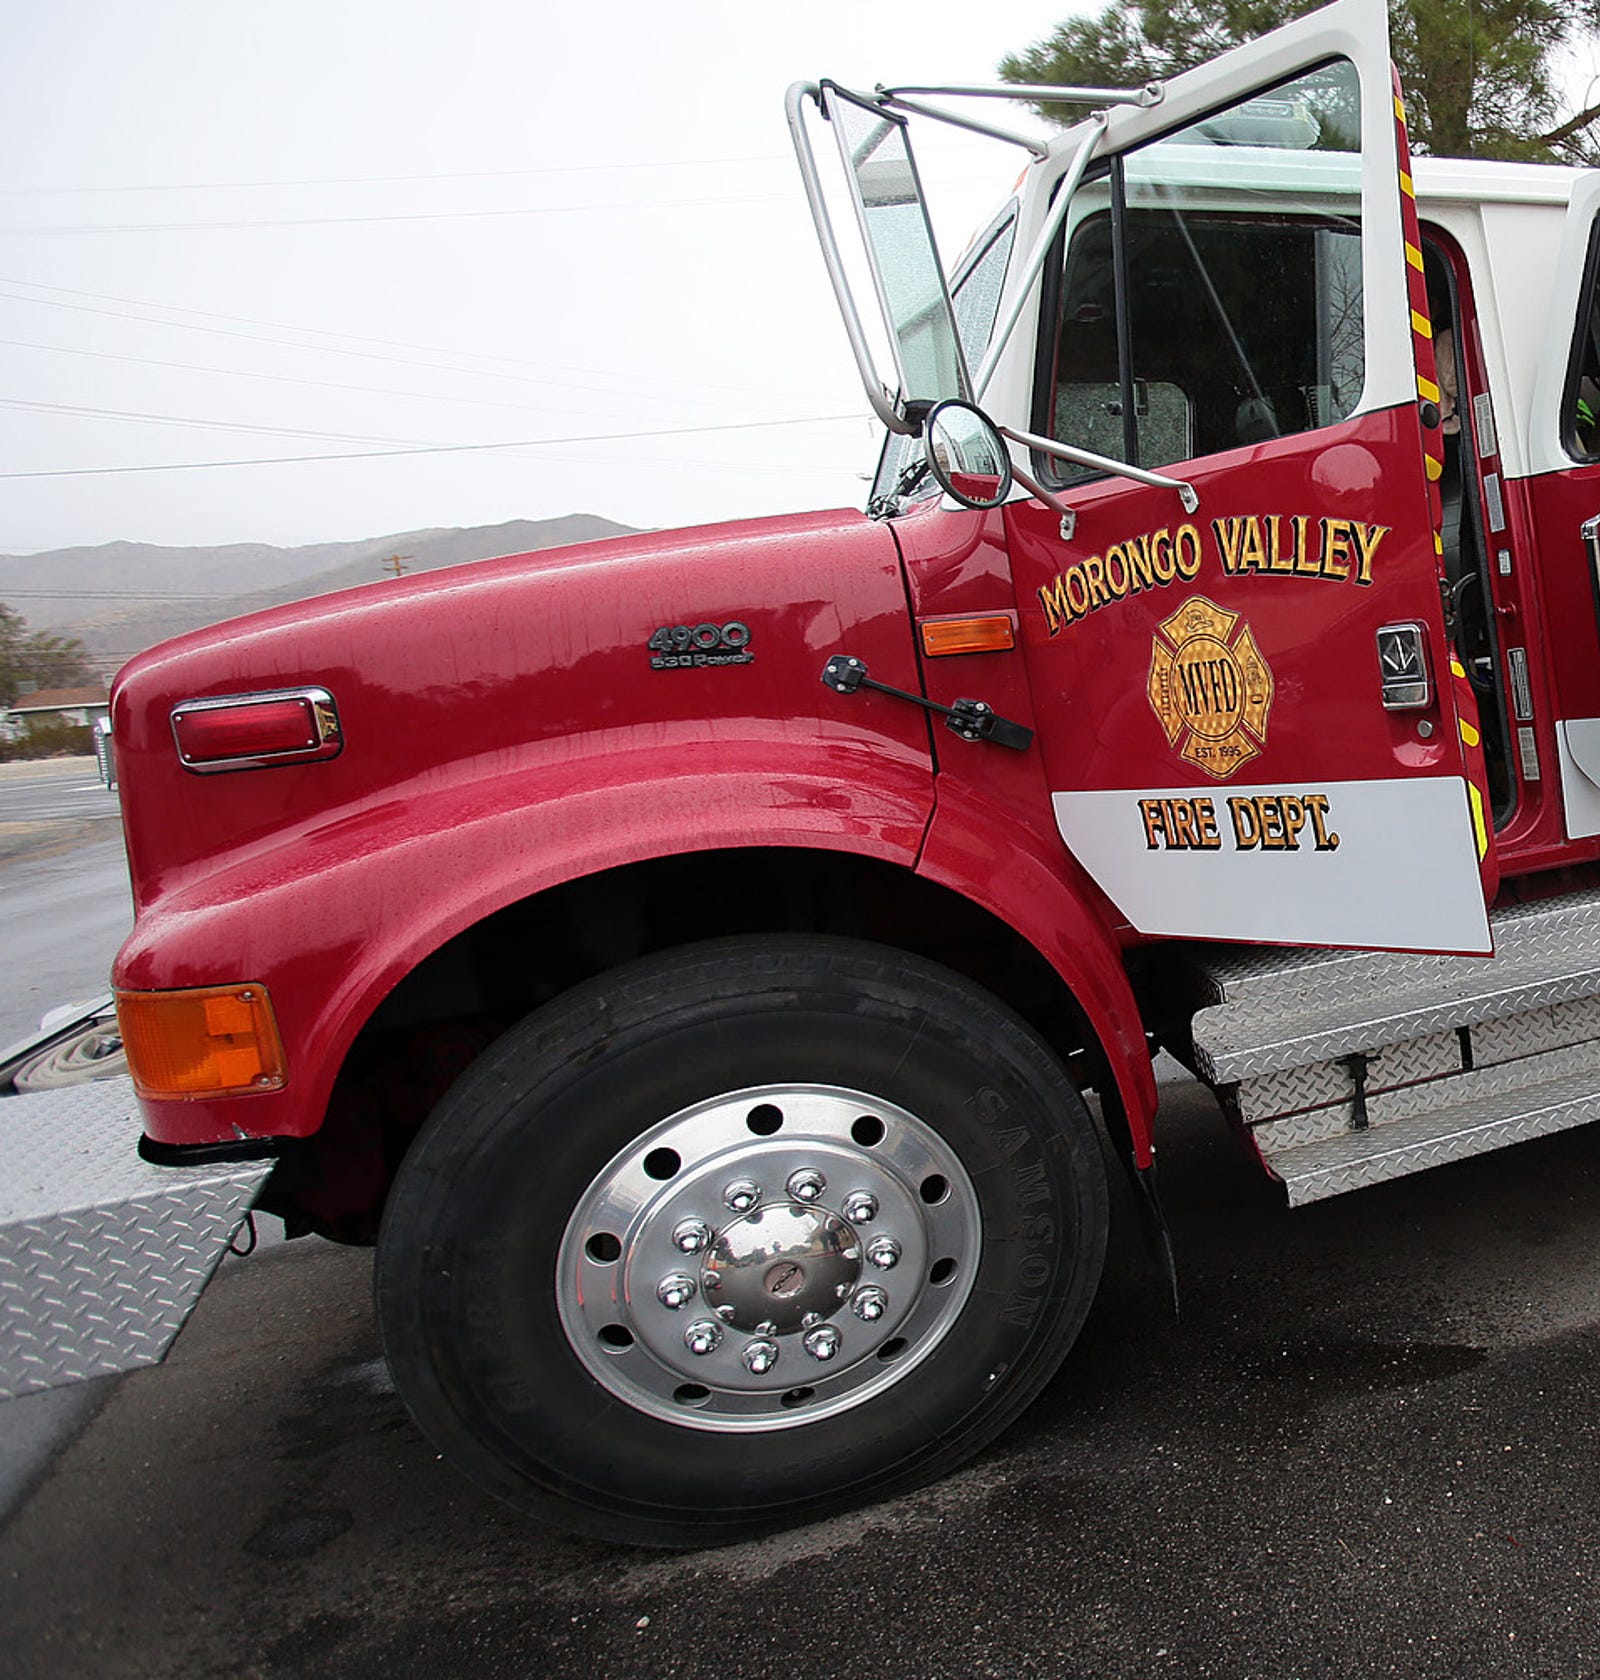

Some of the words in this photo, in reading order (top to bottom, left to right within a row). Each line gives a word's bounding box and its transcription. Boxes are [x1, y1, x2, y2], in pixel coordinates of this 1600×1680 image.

[1036, 523, 1202, 637] MORONGO
[1212, 514, 1393, 586] VALLEY
[649, 621, 751, 651] 4900
[1177, 658, 1238, 716] MVFD
[1194, 746, 1217, 759] EST.
[1218, 744, 1242, 758] 1995
[1137, 796, 1222, 852] FIRE
[1226, 794, 1340, 852] DEPT.
[970, 1085, 1054, 1330] SAMSON
